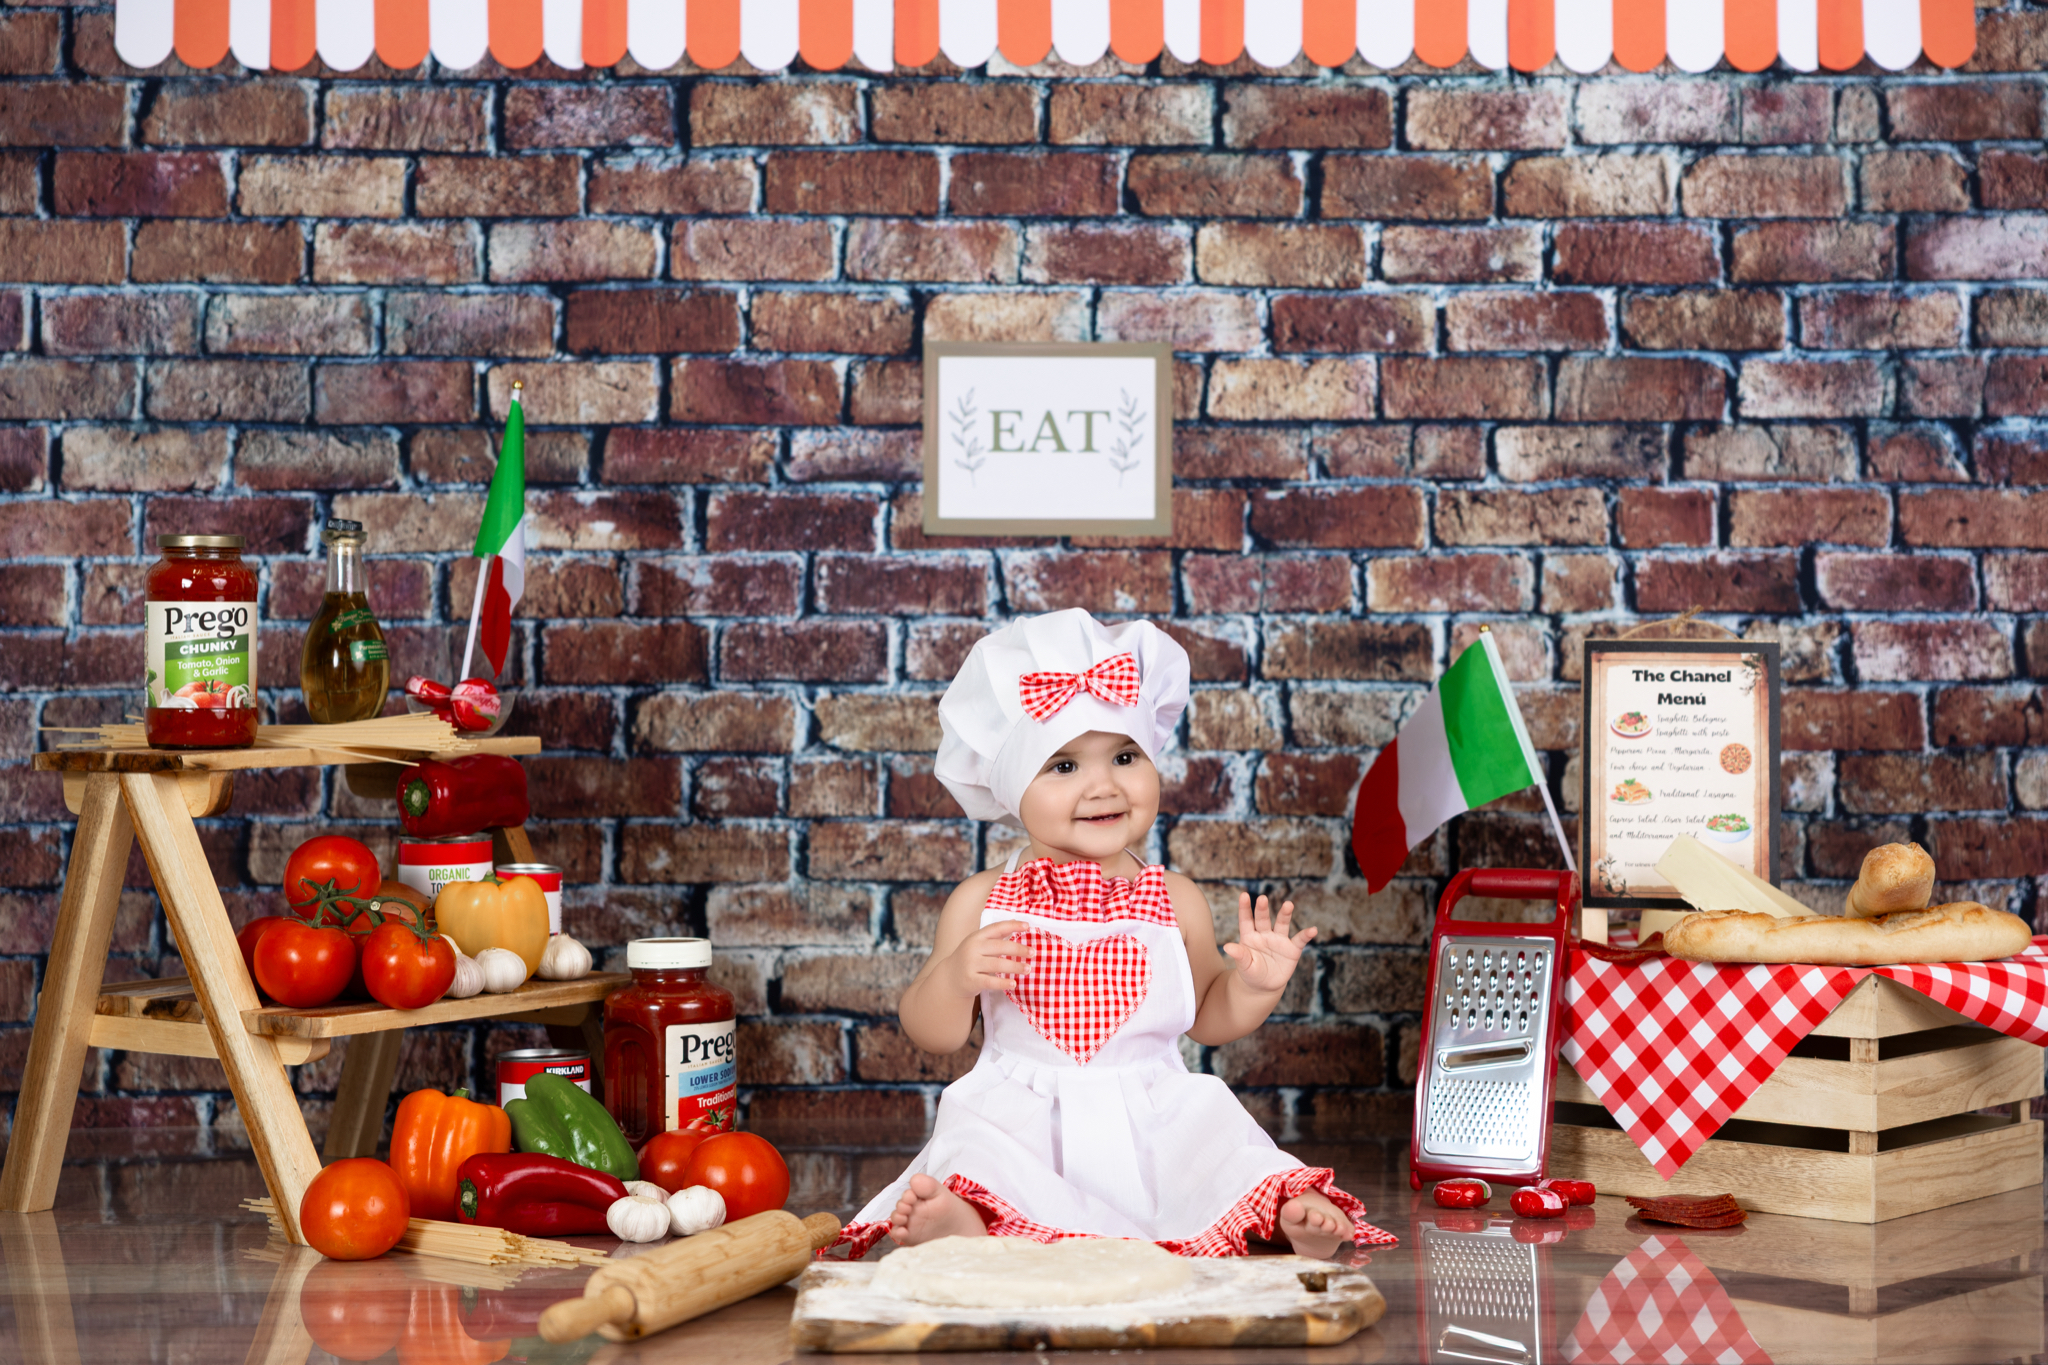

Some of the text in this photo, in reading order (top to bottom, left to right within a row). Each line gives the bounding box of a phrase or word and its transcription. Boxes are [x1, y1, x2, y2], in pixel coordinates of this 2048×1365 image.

[987, 409, 1111, 453] EAT
[164, 607, 248, 639] Prego
[179, 640, 238, 655] CHUNKY
[177, 655, 240, 670] Tomato, Onion
[193, 666, 229, 678] & Garlic
[1632, 669, 1732, 683] The Chanel
[1657, 692, 1707, 706] Menú
[1657, 713, 1727, 724] Spaghetti Bolognese
[1656, 727, 1688, 738] Spaghetti
[1692, 728, 1708, 737] with
[1628, 762, 1648, 771] cheese
[1651, 762, 1665, 771] and
[1659, 788, 1700, 798] Traditional
[1637, 814, 1658, 824] Salad
[1685, 814, 1706, 824] Salad
[1609, 831, 1623, 839] and
[1626, 831, 1674, 839] Mediterranean
[429, 867, 471, 881] ORGANIC
[546, 1065, 584, 1076] KIRKLAND
[690, 1072, 719, 1087] LOWER
[697, 1086, 735, 1108] Traditional
